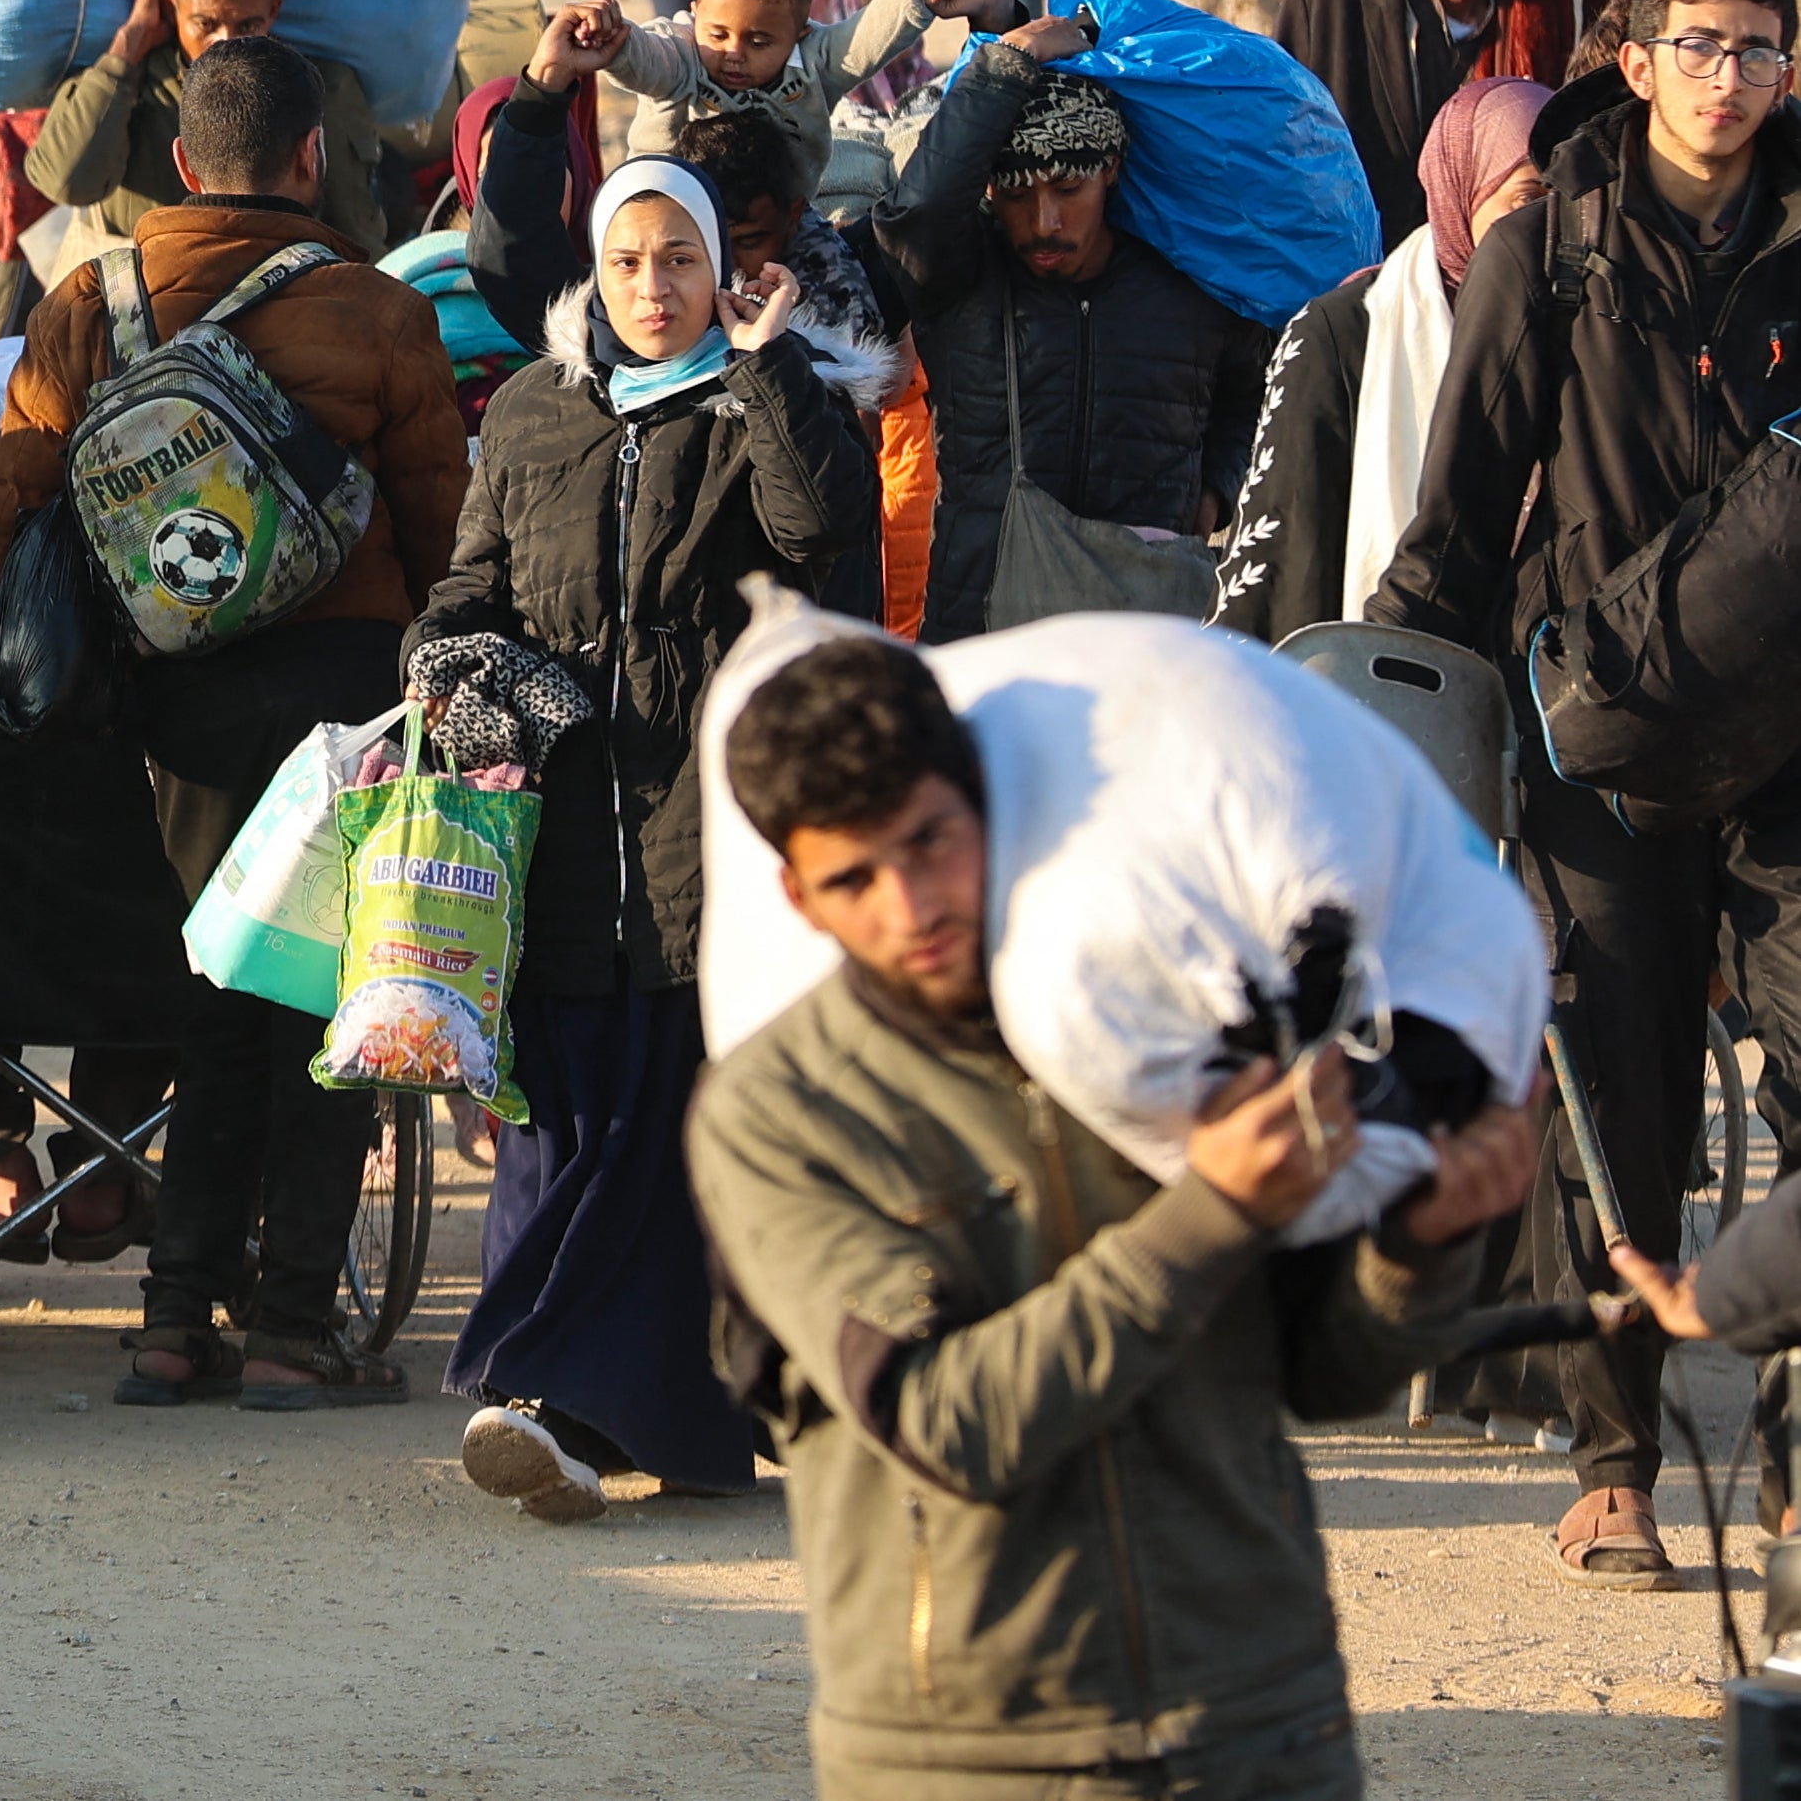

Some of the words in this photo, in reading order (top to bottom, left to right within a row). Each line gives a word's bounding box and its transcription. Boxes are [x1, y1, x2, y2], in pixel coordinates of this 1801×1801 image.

[263, 267, 286, 286] GK
[86, 413, 228, 511] FOOTBALL
[370, 855, 404, 883] ABU
[406, 858, 498, 898] GARBIEH
[420, 890, 496, 915] breakthrough
[264, 930, 287, 952] 16
[383, 919, 417, 932] INDIAN
[418, 923, 466, 940] PREMIUM
[377, 943, 432, 966] Basmati
[435, 956, 467, 973] Rice
